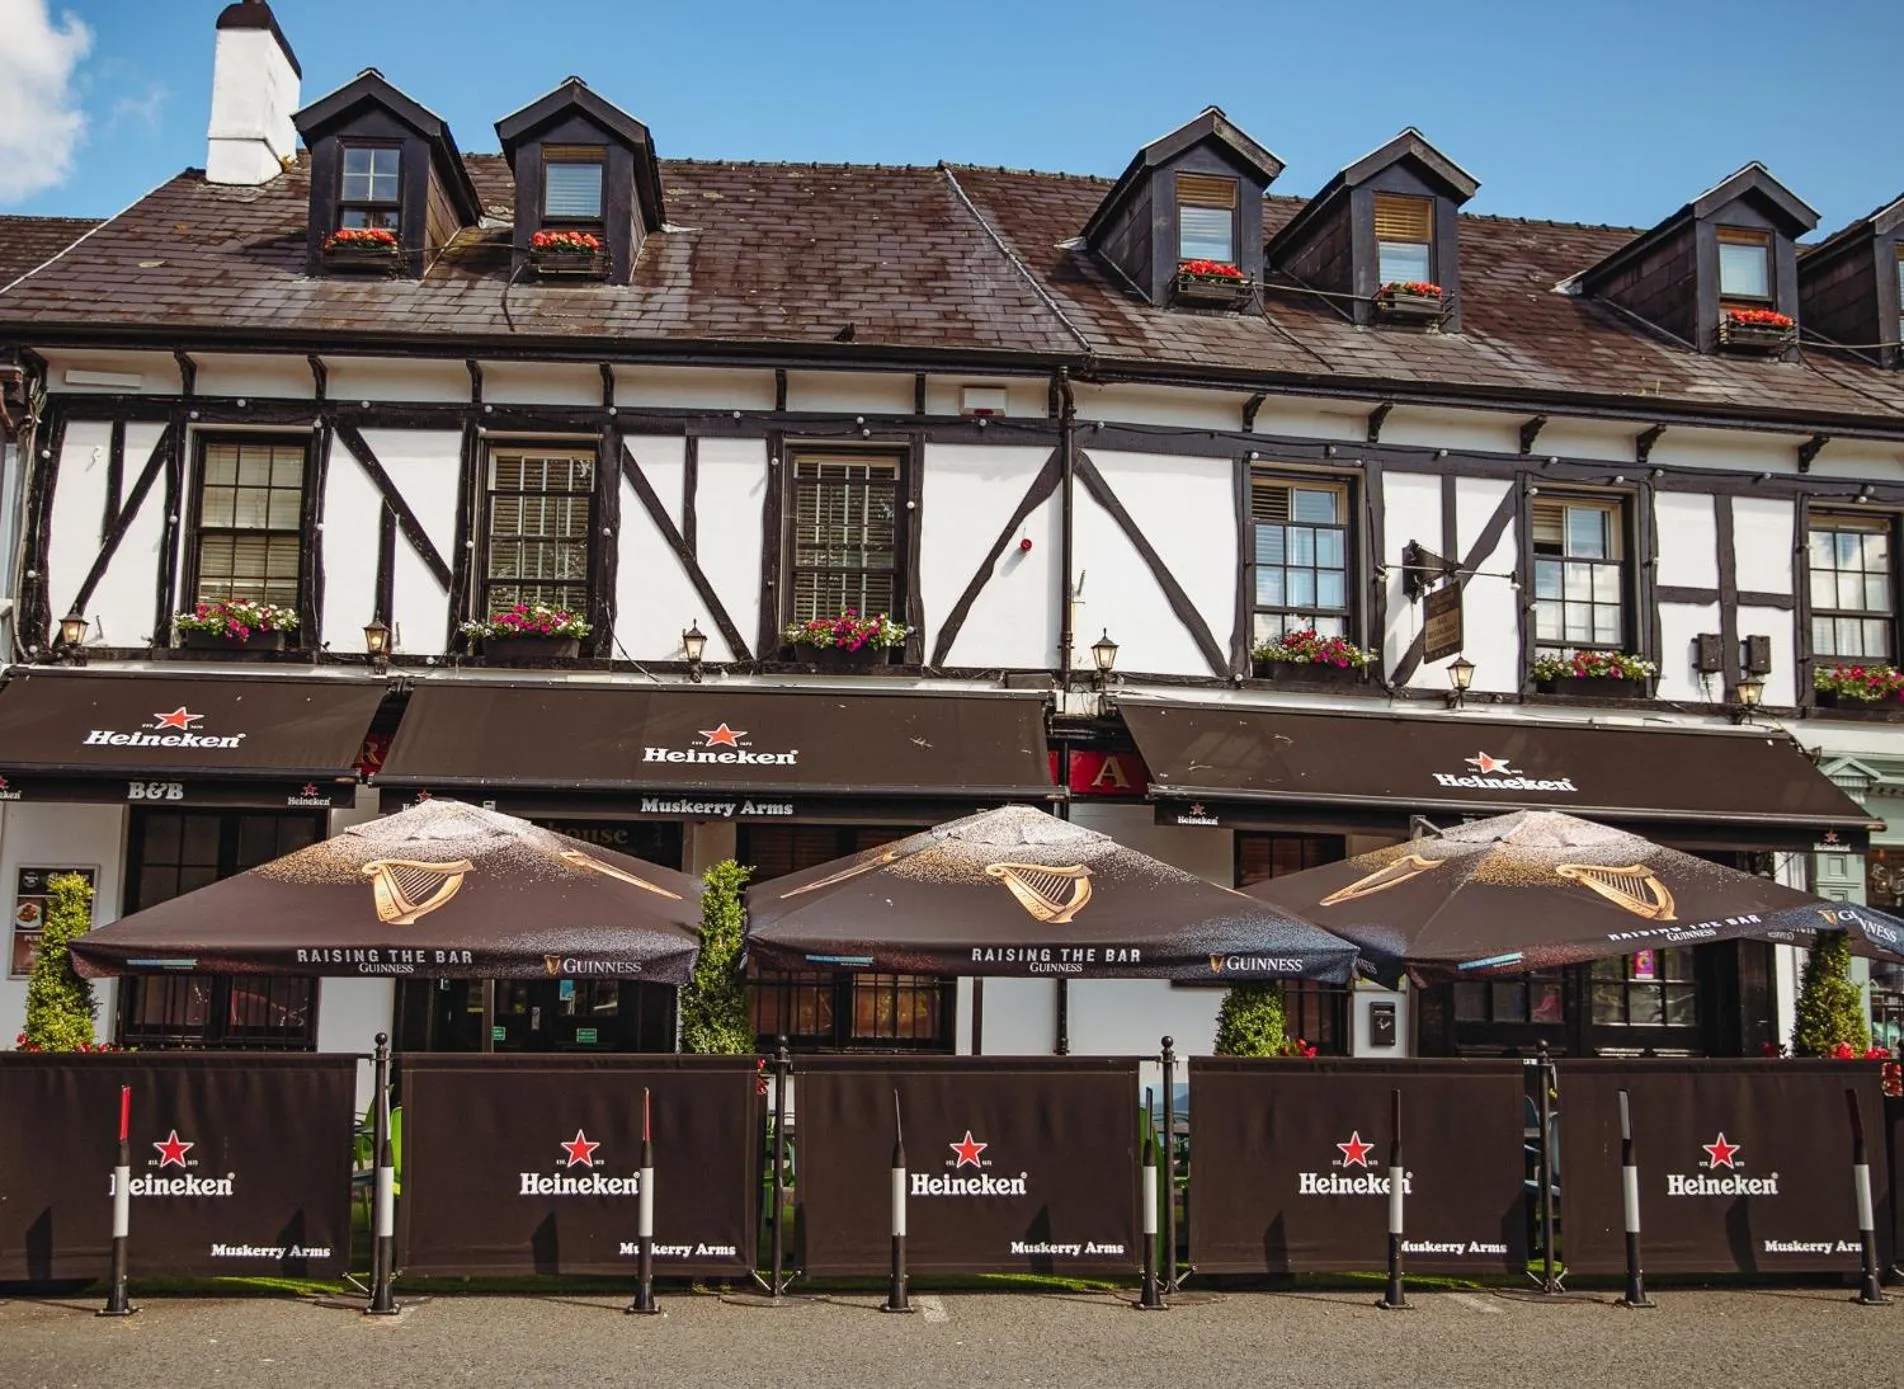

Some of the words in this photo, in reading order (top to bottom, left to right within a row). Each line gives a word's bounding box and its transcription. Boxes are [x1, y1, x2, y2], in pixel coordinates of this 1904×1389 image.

[83, 730, 246, 749] Heineken
[642, 747, 799, 765] Heineken
[1432, 772, 1578, 792] Heineken
[128, 781, 184, 800] B&B
[640, 798, 736, 817] Muskerry
[740, 800, 793, 815] Arms
[297, 950, 380, 963] RAISING
[388, 950, 426, 963] THE
[435, 951, 473, 964] BAR
[971, 948, 1051, 962] RAISING
[1060, 949, 1096, 962] THE
[1105, 949, 1142, 963] BAR
[1226, 955, 1303, 972] GUINNESS
[359, 962, 415, 973] GUINNESS
[563, 958, 642, 974] GUINNESS
[1029, 962, 1083, 973] GUINNESS
[519, 1171, 640, 1195] Heineken
[910, 1171, 1028, 1196] Heineken
[1667, 1172, 1779, 1196] Heineken
[211, 1244, 286, 1259] Muskerry
[289, 1245, 331, 1257] Arms
[695, 1242, 737, 1256] Arms
[1010, 1241, 1082, 1257] Muskerry
[1083, 1241, 1125, 1255] Arms
[1468, 1240, 1508, 1253] Arms
[1764, 1240, 1834, 1255] Muskerry
